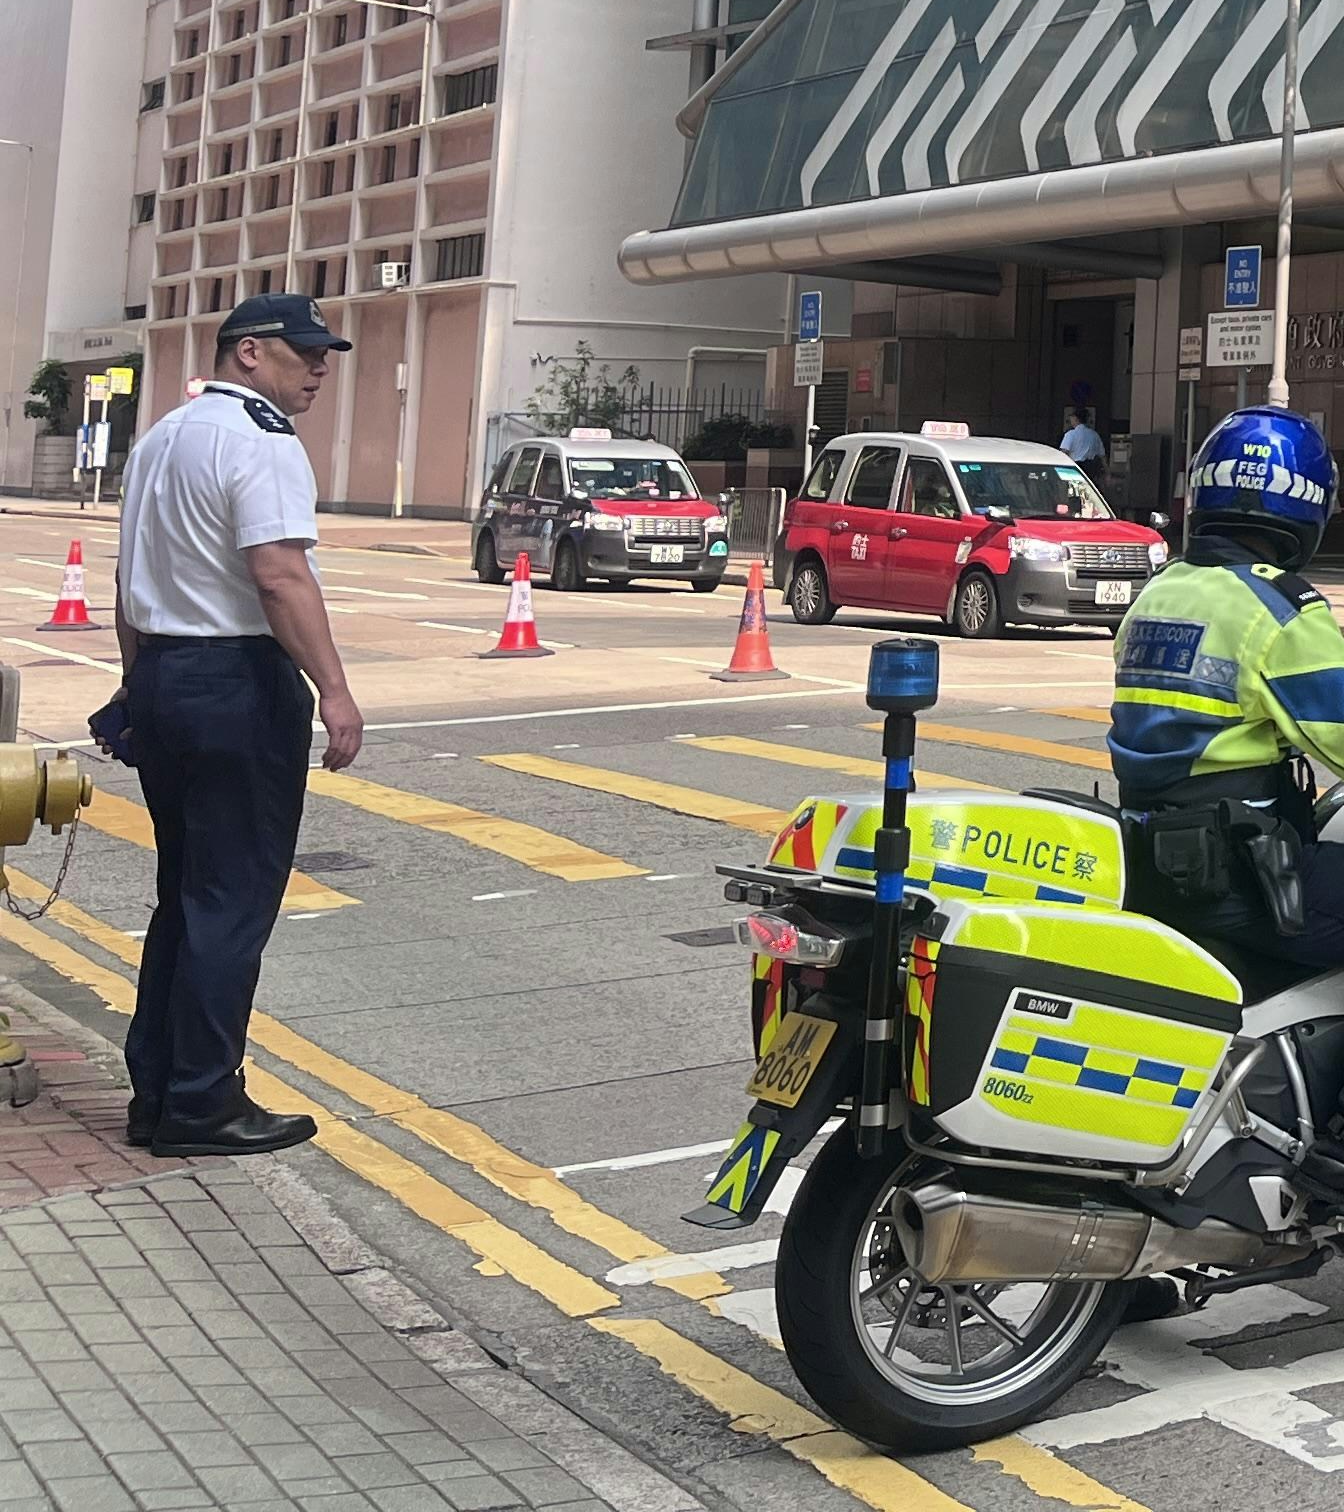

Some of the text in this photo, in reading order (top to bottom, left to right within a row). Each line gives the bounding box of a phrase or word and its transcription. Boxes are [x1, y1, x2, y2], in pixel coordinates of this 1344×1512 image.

[1239, 259, 1248, 268] NO
[1234, 269, 1251, 278] ENTRY
[1244, 444, 1271, 458] W10
[1237, 461, 1267, 476] FEG
[1235, 474, 1266, 489] POLICE
[1107, 582, 1122, 592] XN
[1100, 592, 1126, 603] 1940
[1027, 998, 1060, 1014] BMW
[783, 1020, 821, 1058] AM
[754, 1051, 811, 1096] 8060
